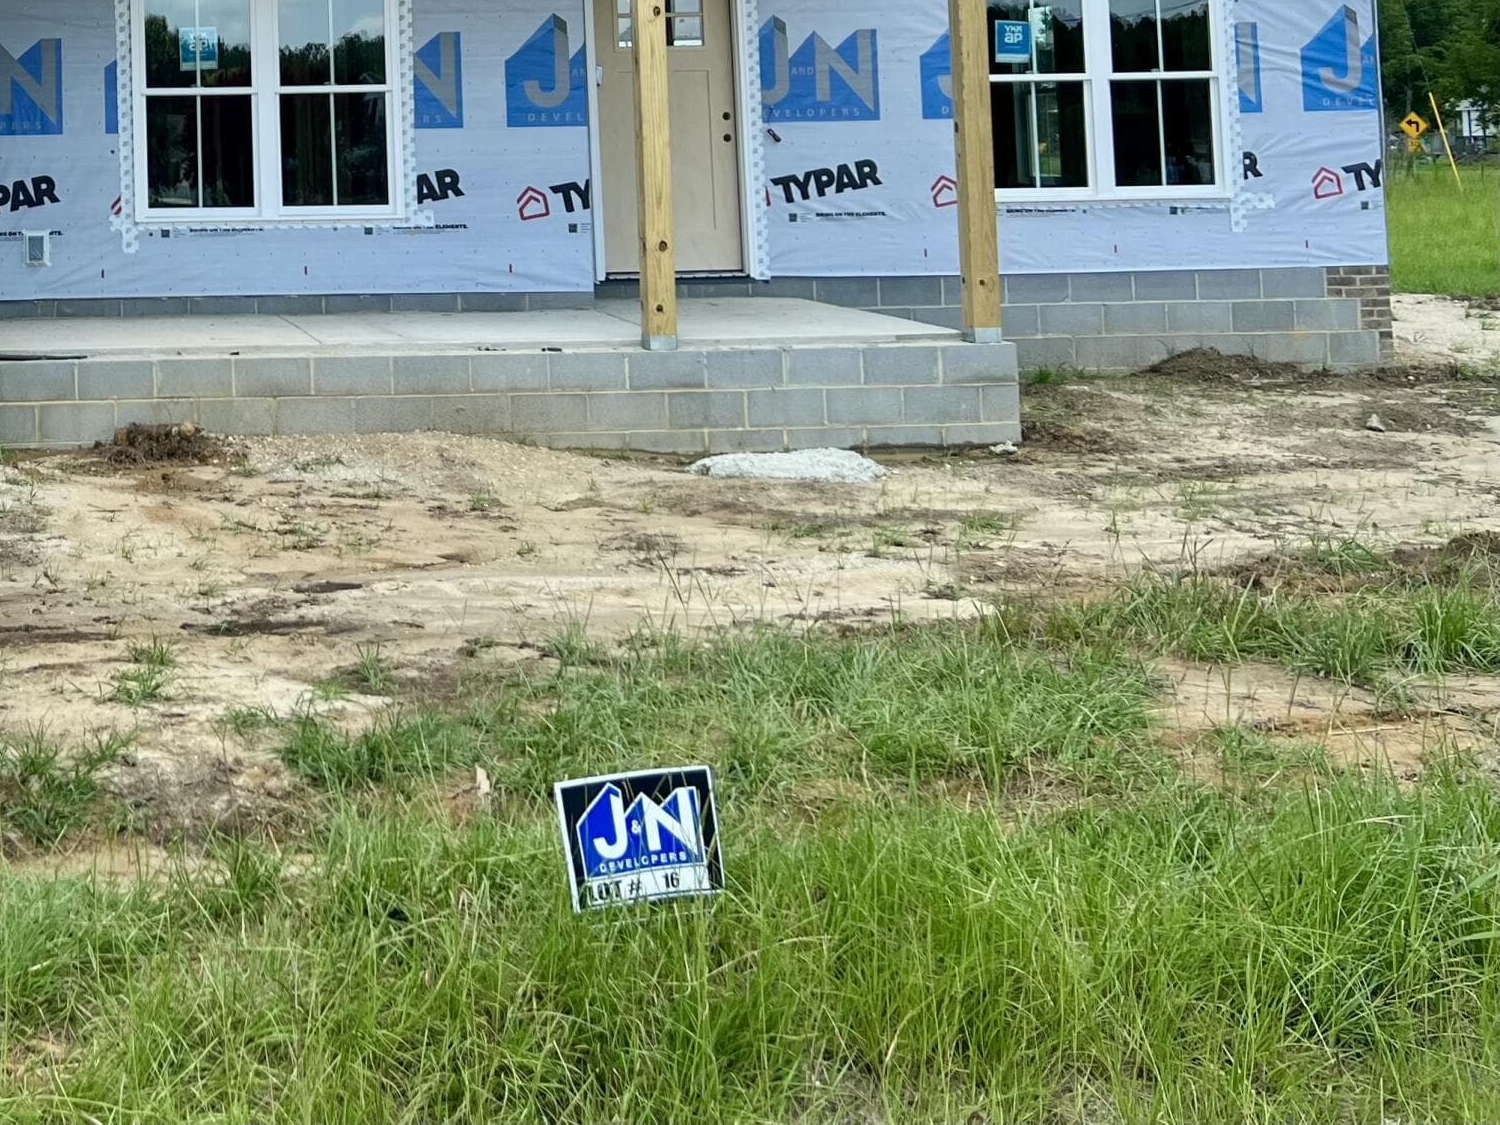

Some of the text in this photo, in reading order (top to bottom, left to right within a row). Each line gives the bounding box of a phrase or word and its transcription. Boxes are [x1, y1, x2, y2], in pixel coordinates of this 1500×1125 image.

[524, 13, 570, 108] J
[1004, 32, 1023, 44] ap
[1319, 4, 1361, 93] J
[790, 66, 814, 76] AND
[813, 30, 874, 112] N
[527, 112, 585, 123] DEVEL
[770, 159, 883, 204] TYPAR
[593, 787, 699, 860] J & N
[600, 851, 687, 873] DEVELOPERS
[663, 871, 680, 888] 16
